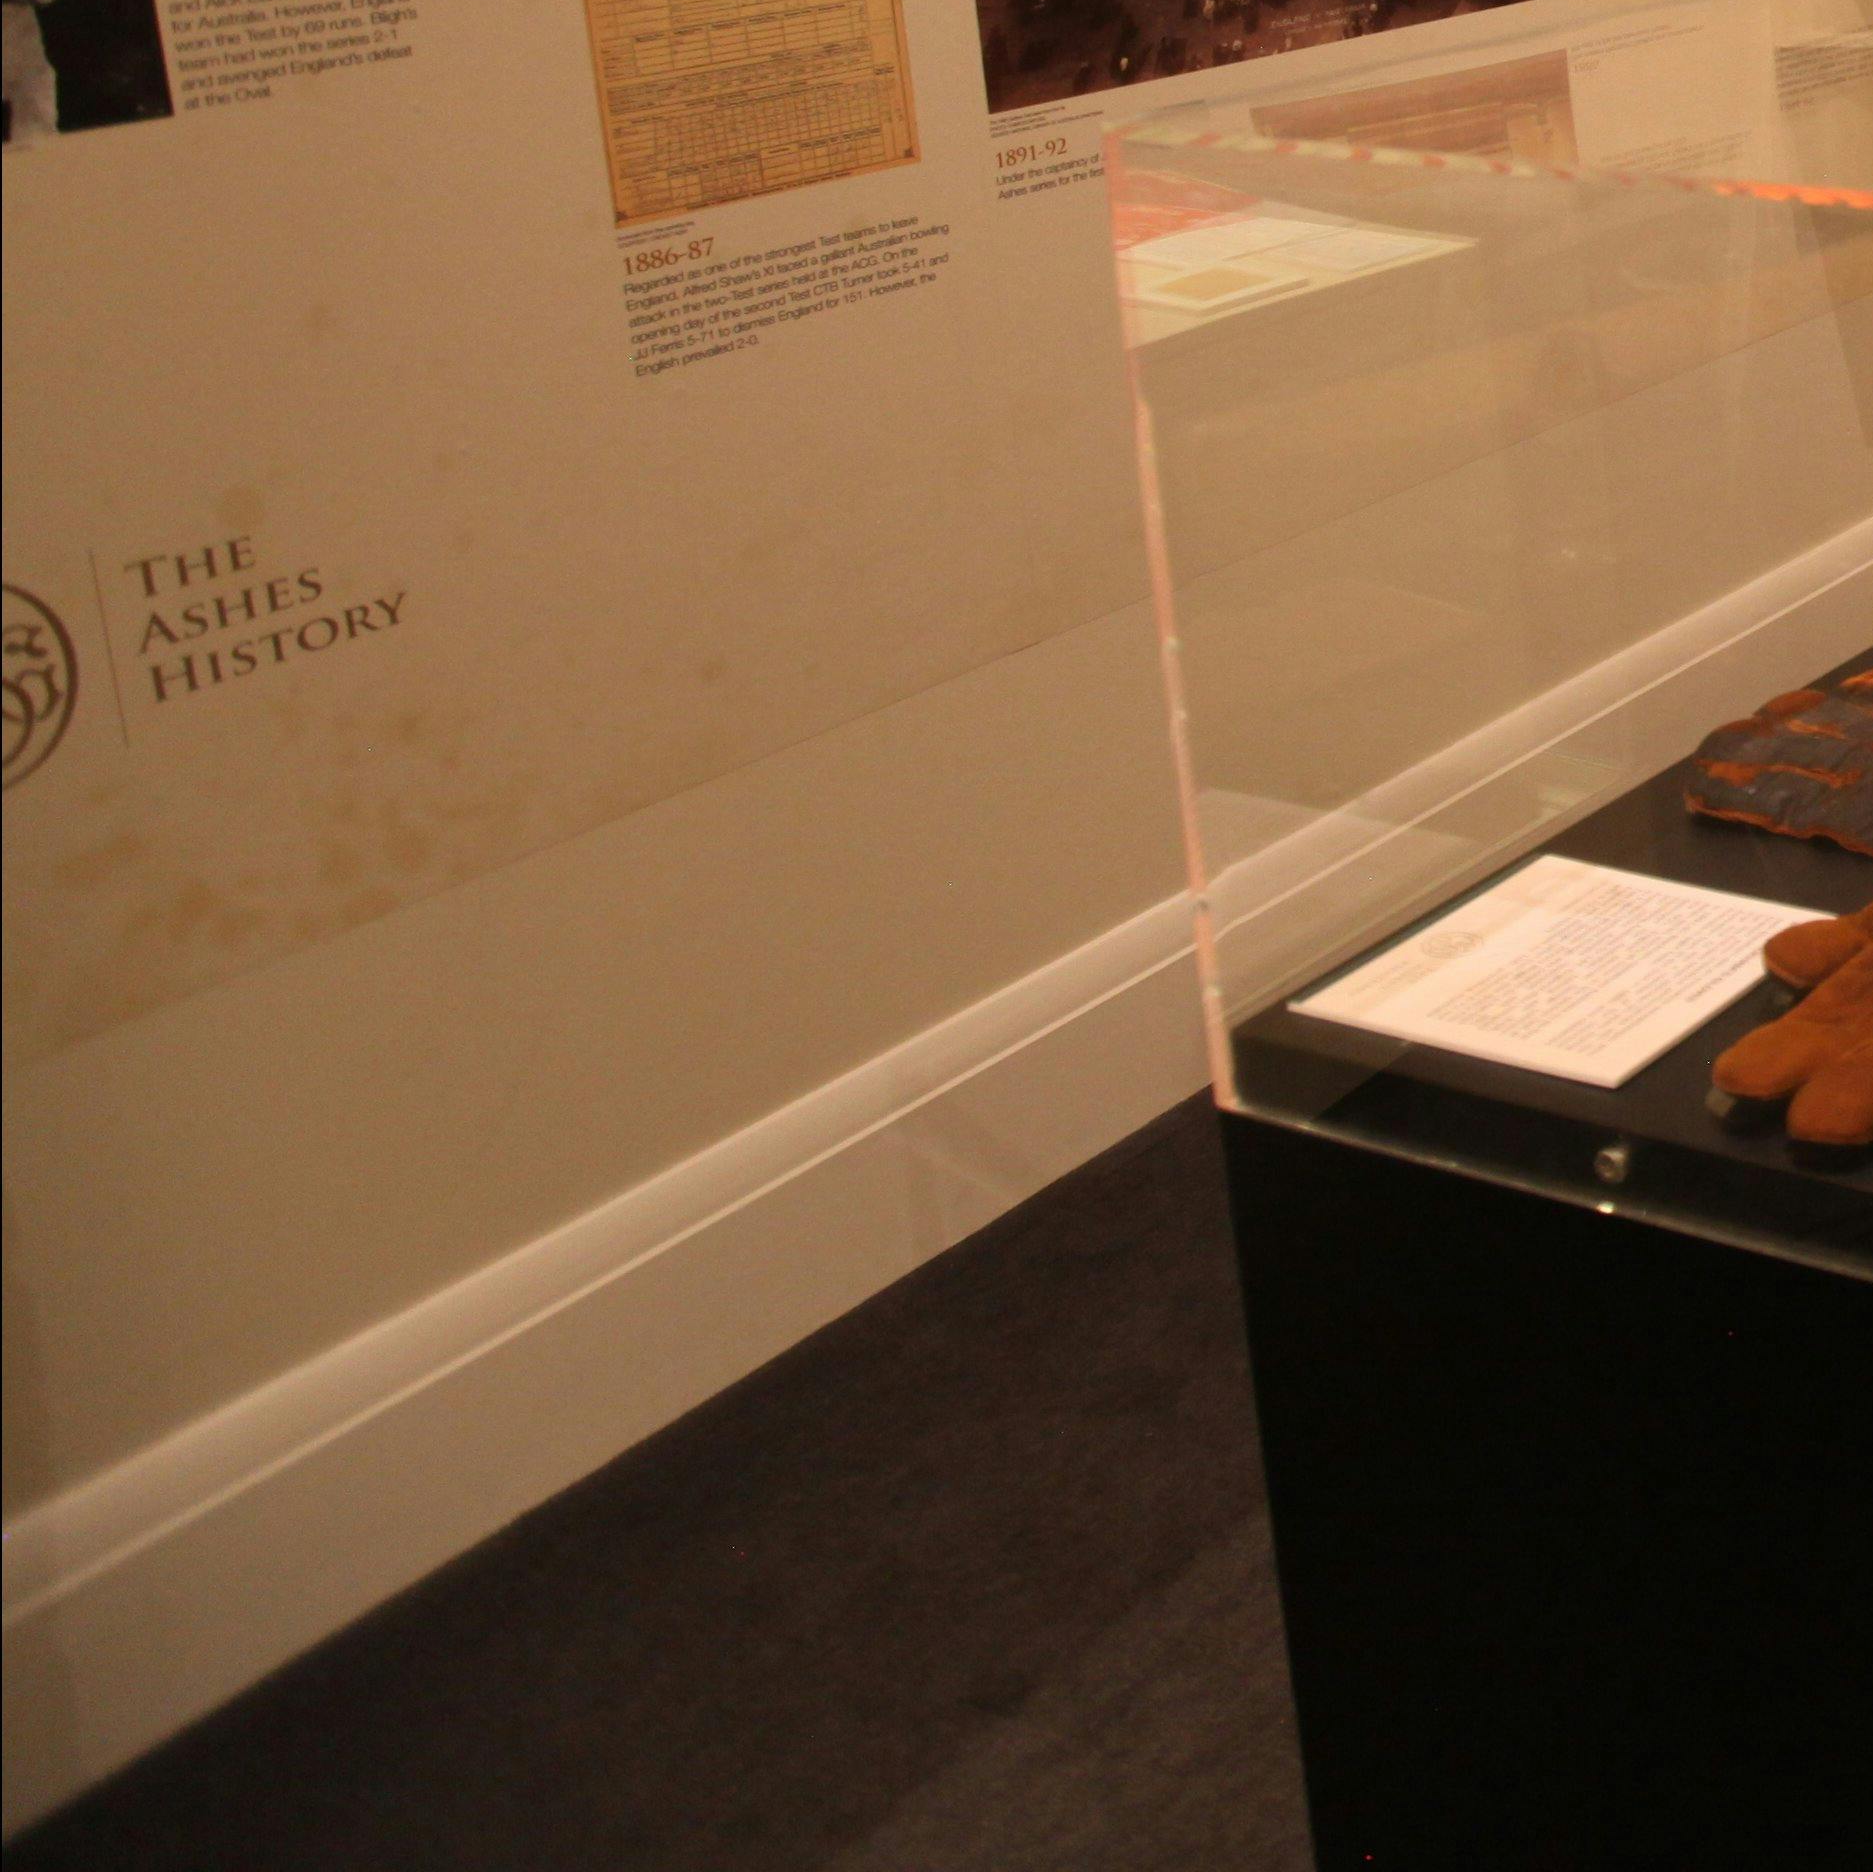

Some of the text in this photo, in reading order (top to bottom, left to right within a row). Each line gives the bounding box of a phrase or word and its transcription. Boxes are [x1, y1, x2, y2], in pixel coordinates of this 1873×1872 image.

[996, 138, 1067, 168] 1891-92
[623, 237, 714, 276] 1886-87
[123, 535, 258, 599] THE
[139, 567, 324, 655] ASHES
[149, 591, 407, 704] HISTORY
